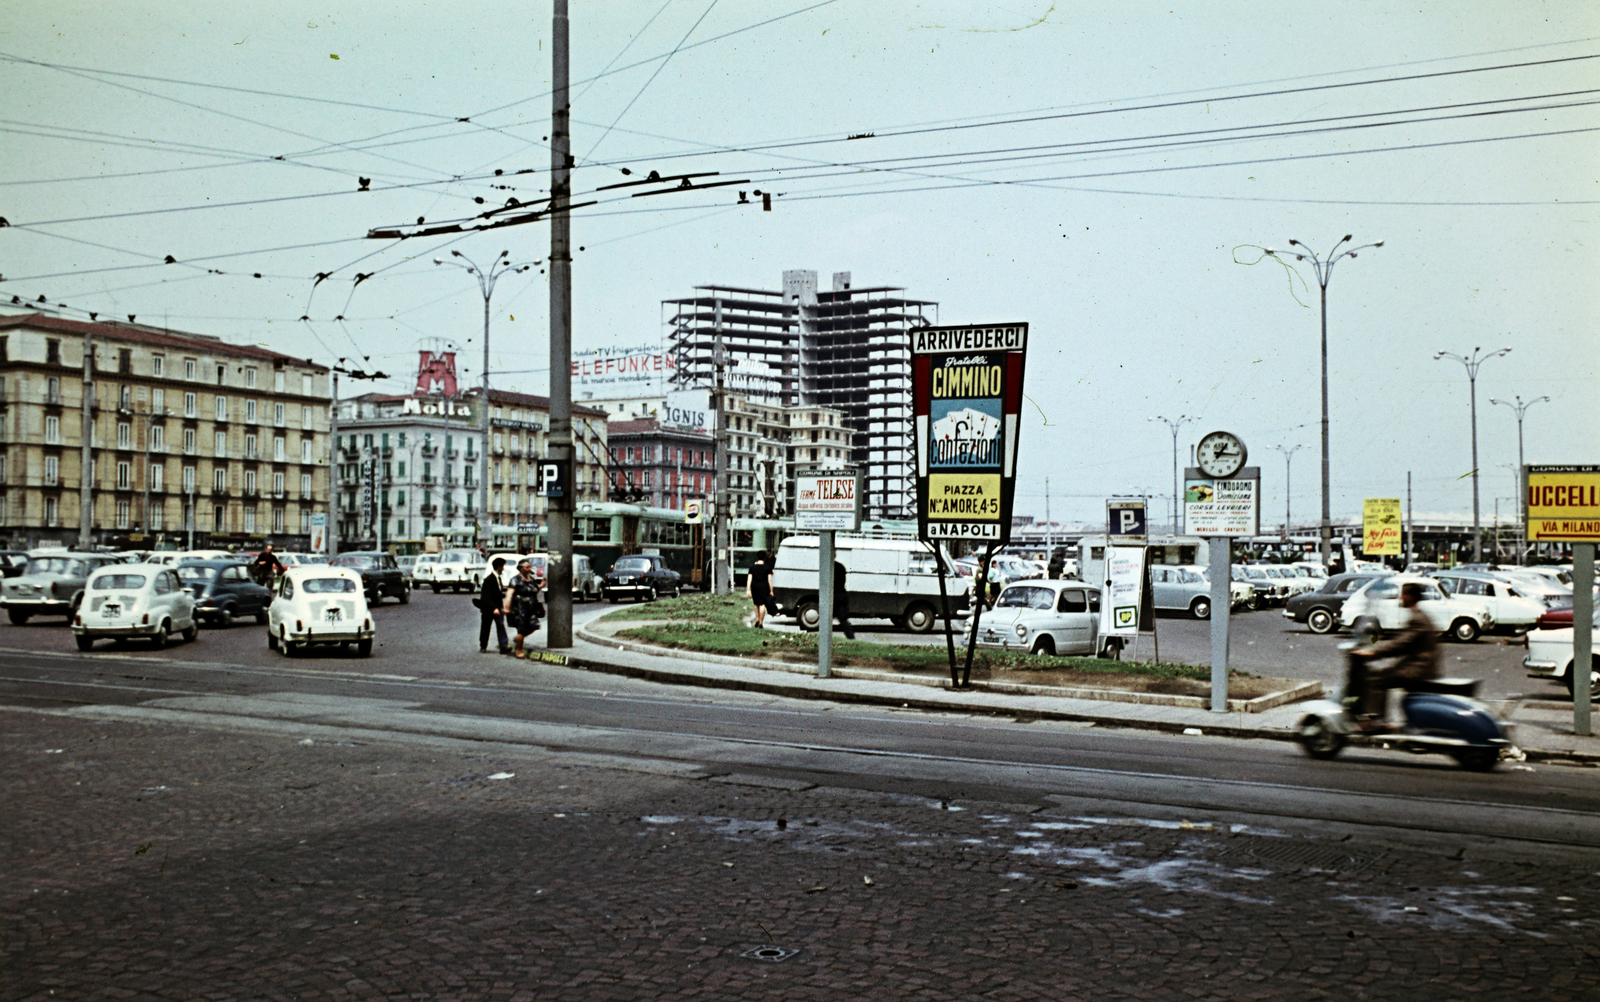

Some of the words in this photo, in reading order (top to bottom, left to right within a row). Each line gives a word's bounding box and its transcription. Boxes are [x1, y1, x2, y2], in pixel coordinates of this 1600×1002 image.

[917, 328, 1020, 350] ARRIVEDERCI
[932, 365, 1002, 397] CIMMINO
[667, 407, 705, 427] IGNIS
[931, 421, 1001, 465] confezioni
[543, 464, 558, 496] P
[817, 479, 854, 500] TELESE
[944, 485, 983, 495] PIAZZA
[1529, 485, 1600, 507] UCCELL
[931, 526, 937, 535] a
[940, 524, 996, 537] NAPOLI
[1120, 510, 1135, 533] P
[1542, 521, 1558, 532] VIA
[1562, 521, 1600, 533] MILANO
[1121, 612, 1132, 621] BP
